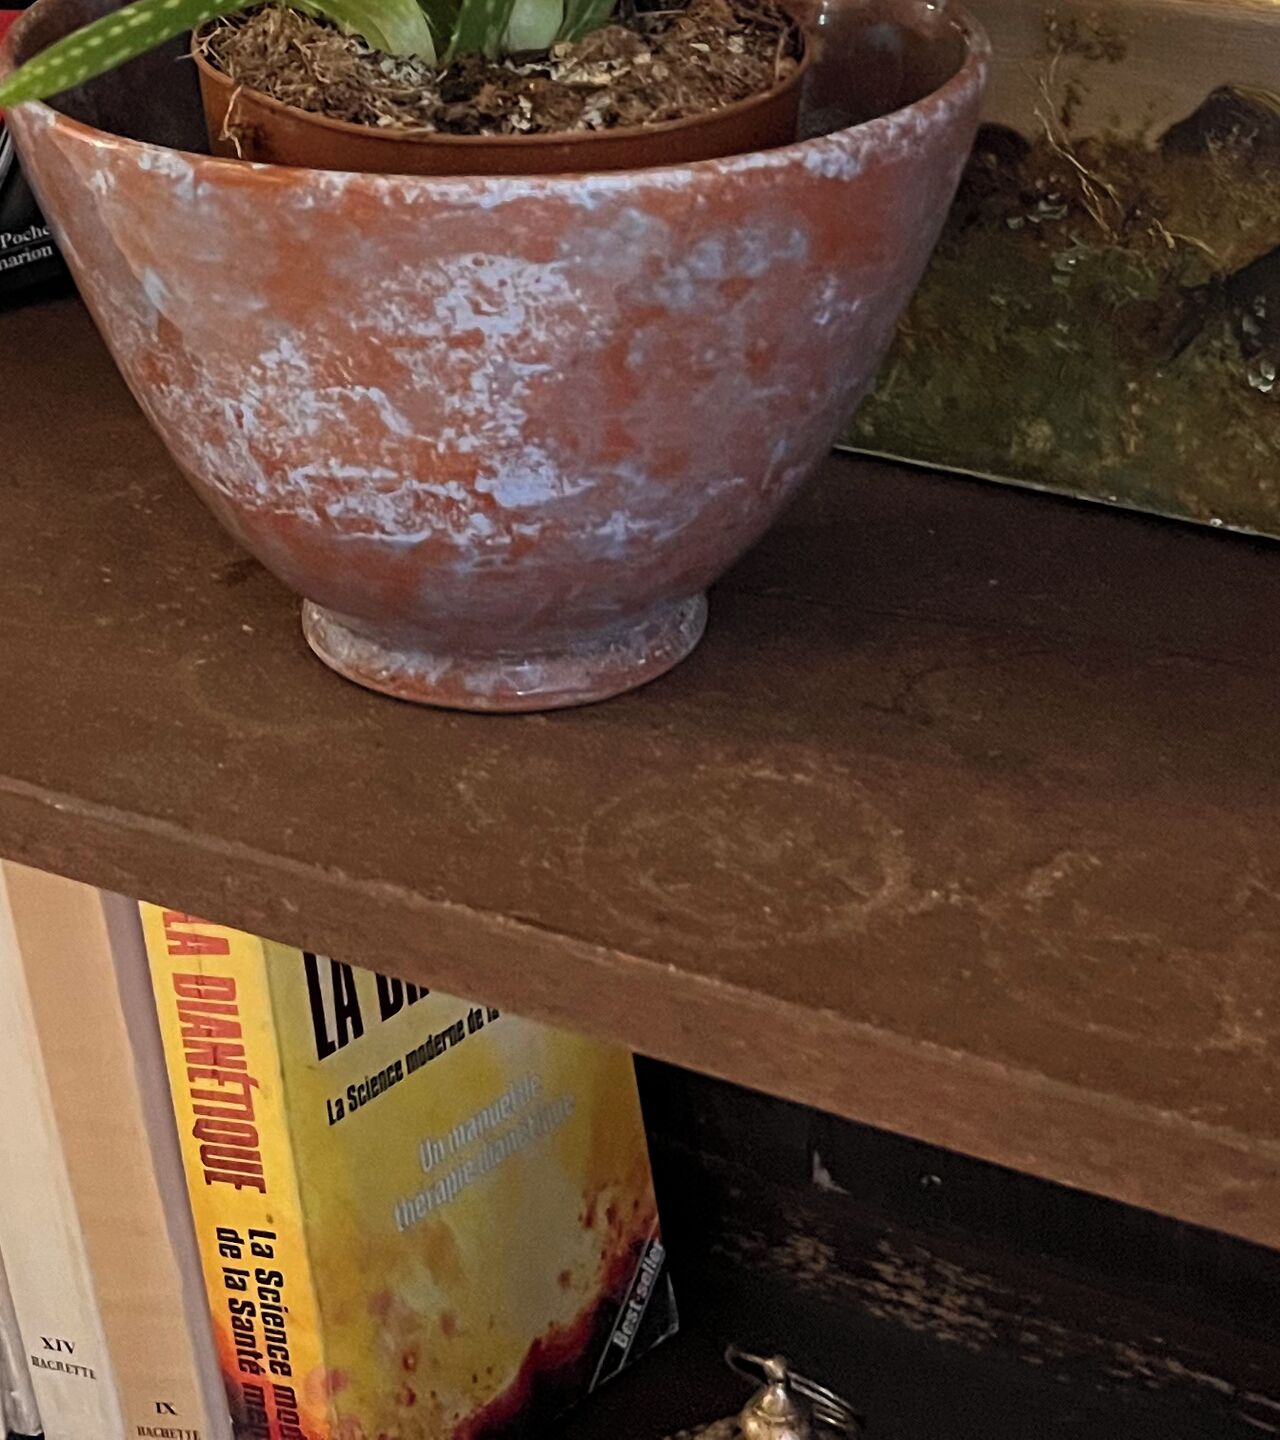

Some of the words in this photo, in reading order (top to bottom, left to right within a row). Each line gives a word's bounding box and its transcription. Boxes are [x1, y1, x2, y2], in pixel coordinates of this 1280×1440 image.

[0, 225, 51, 249] Poche
[163, 911, 230, 955] LA
[303, 951, 364, 1061] LA
[326, 1097, 345, 1126] La
[347, 1059, 404, 1112] Science
[405, 1019, 466, 1074] moderne
[467, 1008, 484, 1035] de
[172, 973, 267, 1194] DIANÉTIQUE
[419, 1137, 445, 1174] Un
[216, 1227, 245, 1259] de
[248, 1228, 276, 1259] La
[222, 1267, 250, 1291] la
[228, 1297, 266, 1375] Santé
[255, 1268, 292, 1377] Science
[40, 1336, 76, 1355] XIV
[30, 1355, 97, 1380] HACHETTE
[154, 1402, 178, 1416] IX
[136, 1425, 201, 1440] HACHETTE
